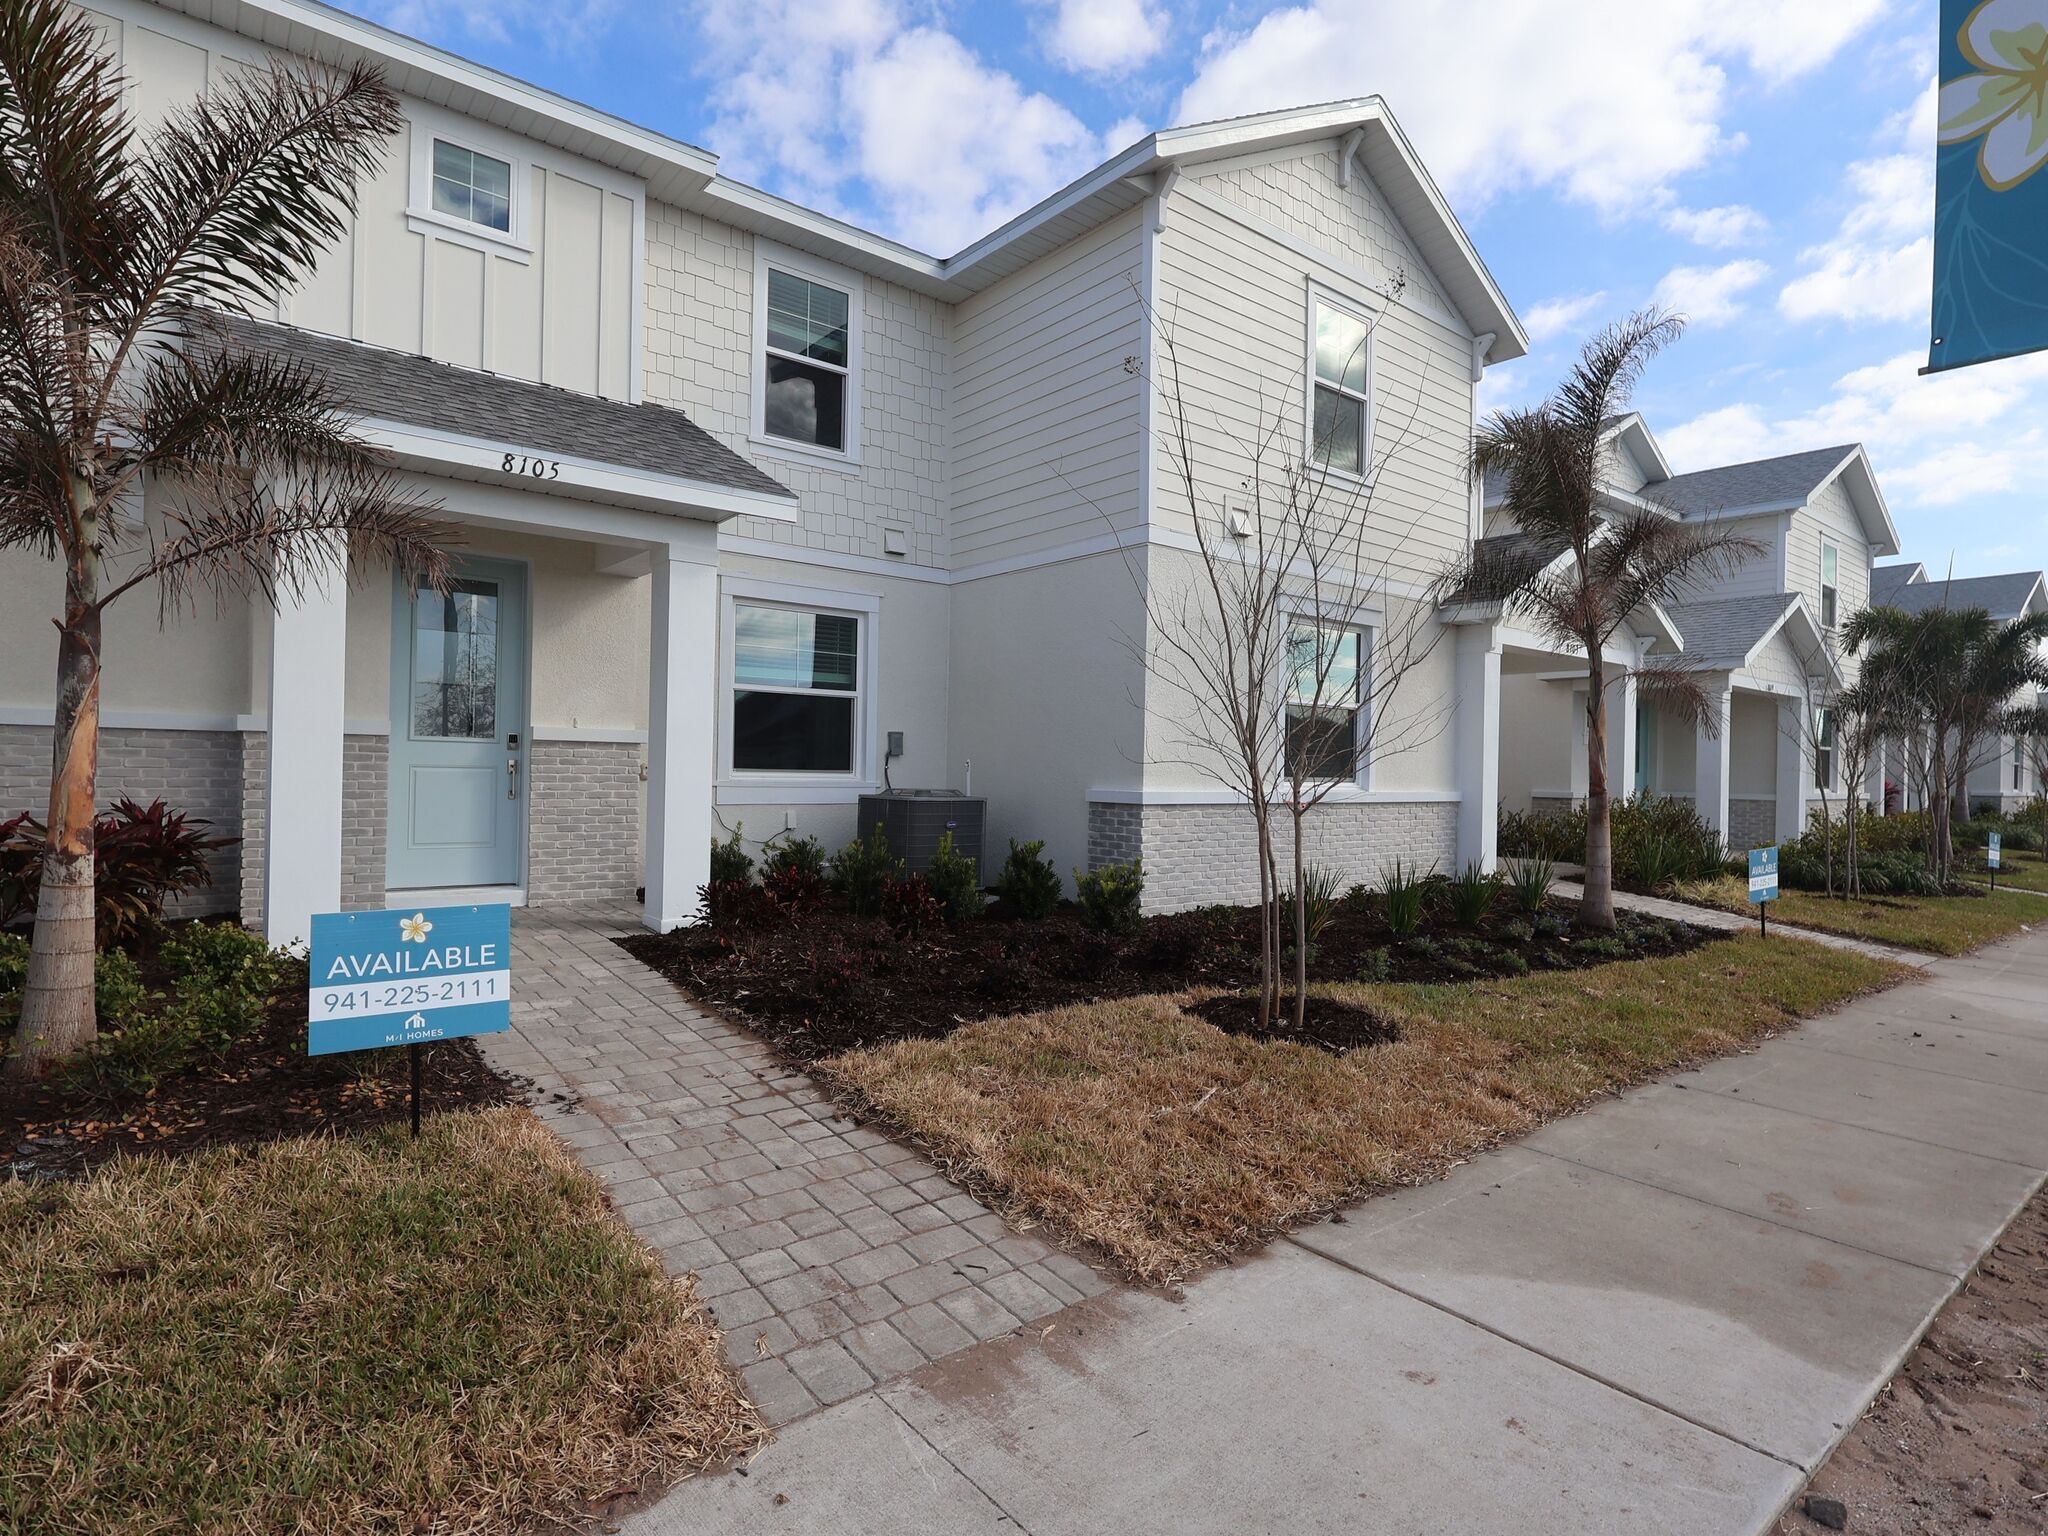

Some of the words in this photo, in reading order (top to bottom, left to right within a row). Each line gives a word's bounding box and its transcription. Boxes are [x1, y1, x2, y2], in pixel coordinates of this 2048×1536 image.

[503, 454, 560, 479] 8105
[327, 944, 496, 980] AVAILABLE
[324, 978, 496, 1012] 941-225-2111
[407, 1029, 444, 1040] HOMES
